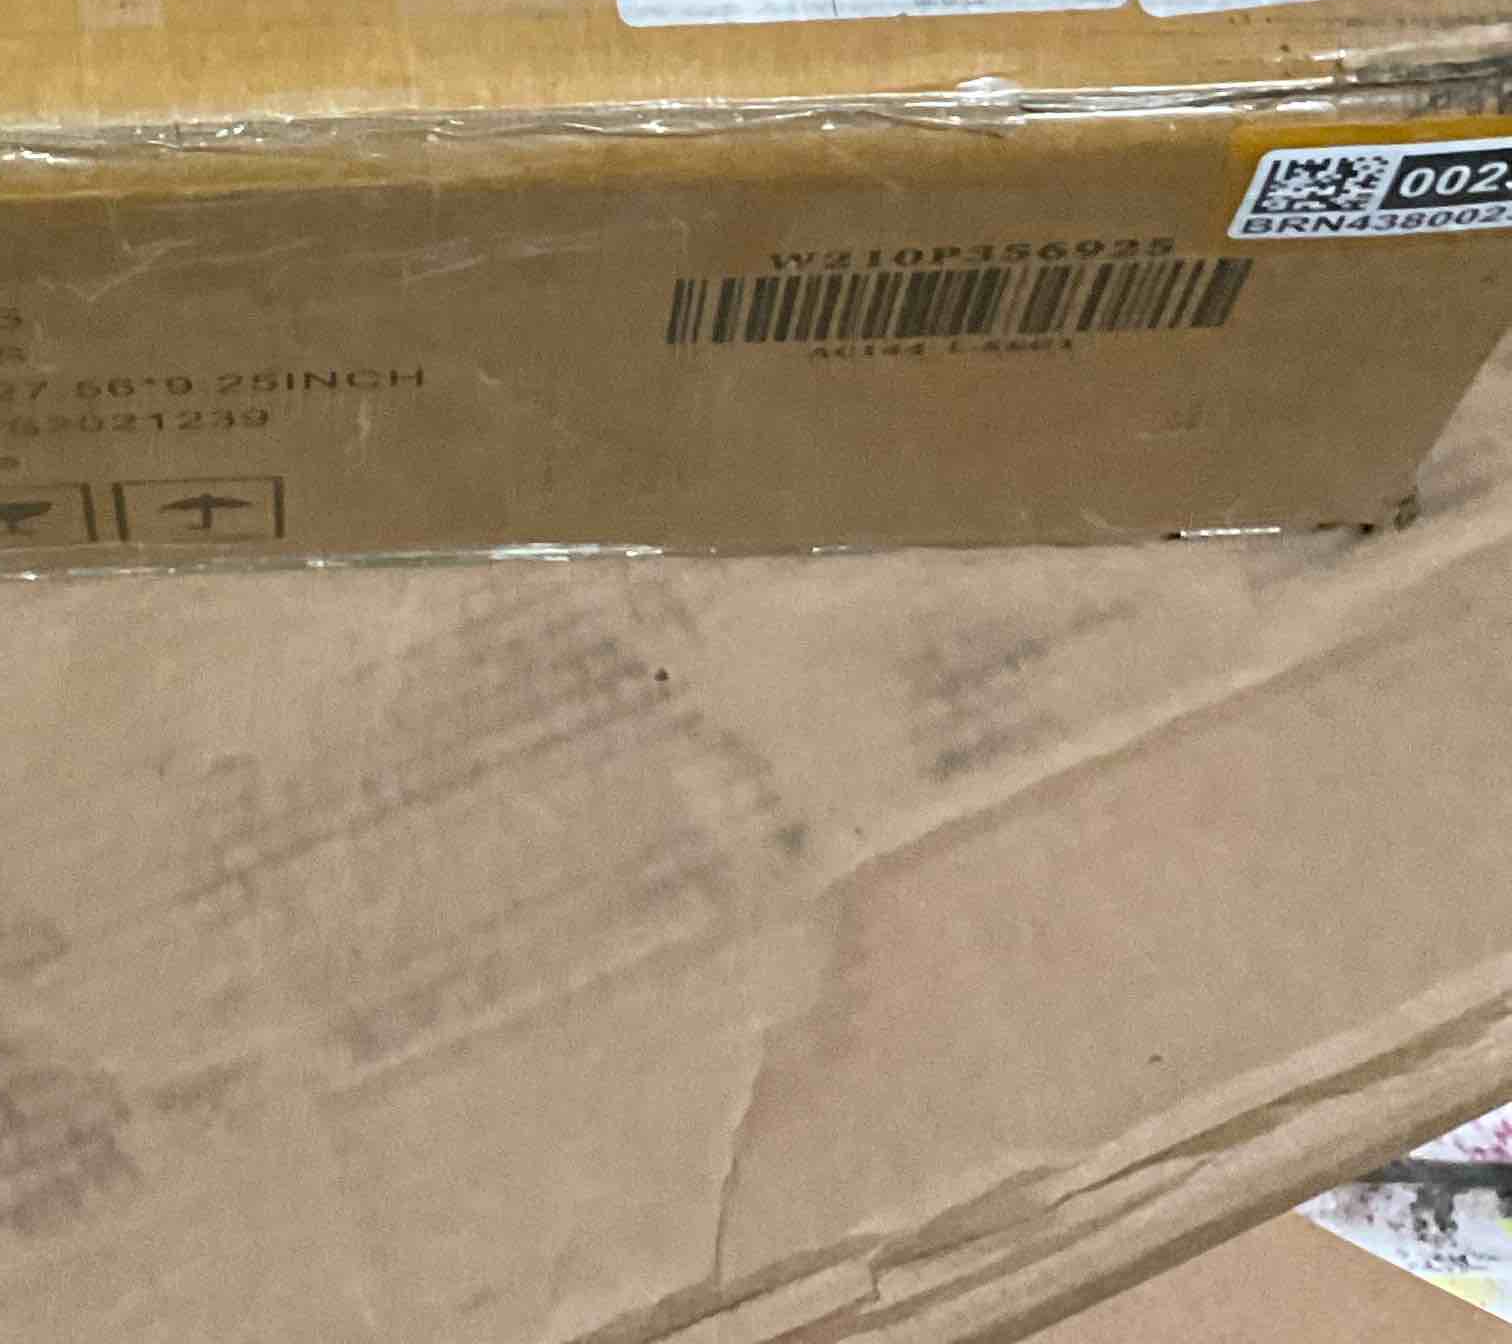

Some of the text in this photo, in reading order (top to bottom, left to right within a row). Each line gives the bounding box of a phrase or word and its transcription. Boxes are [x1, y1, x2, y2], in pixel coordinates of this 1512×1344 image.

[1400, 161, 1512, 199] 002
[1242, 205, 1512, 235] BRN438002
[769, 237, 1177, 272] W210P356925
